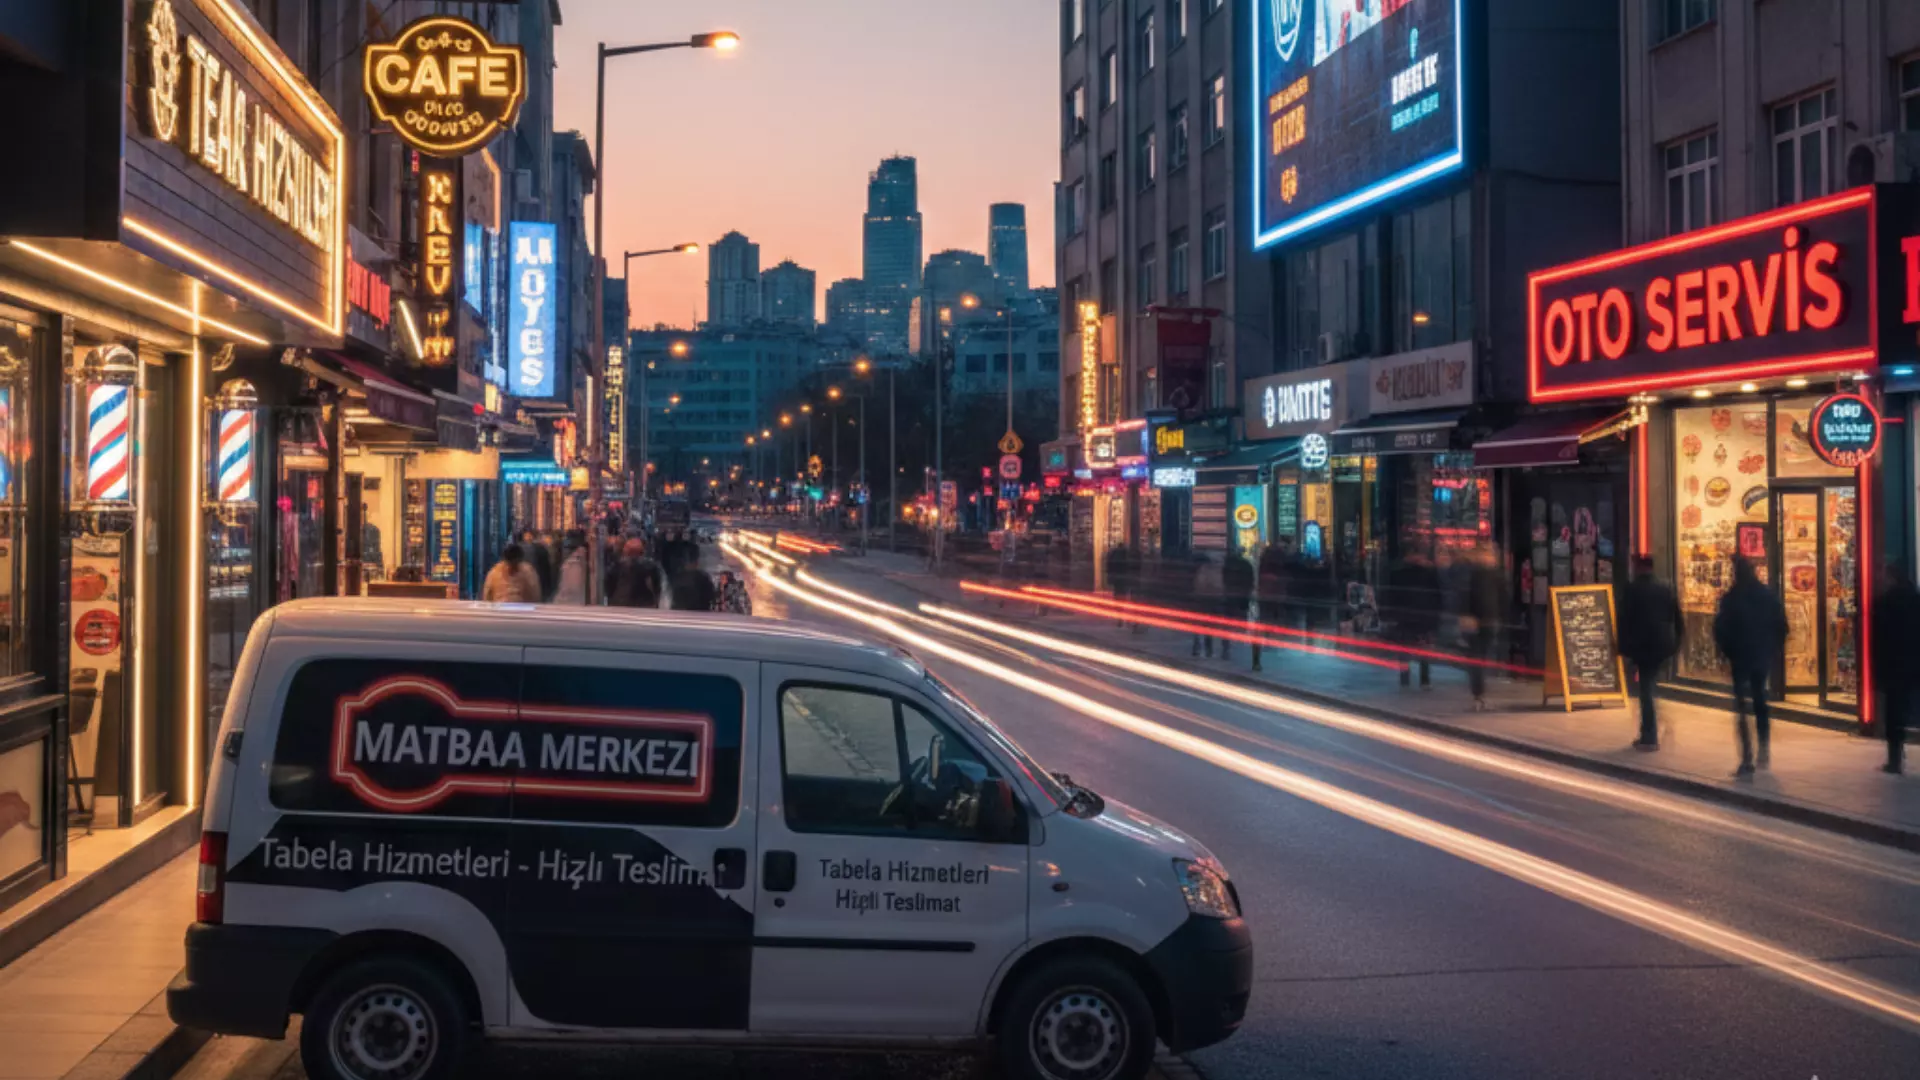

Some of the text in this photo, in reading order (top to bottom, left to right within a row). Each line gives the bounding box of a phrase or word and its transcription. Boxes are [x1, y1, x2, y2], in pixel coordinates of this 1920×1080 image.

[375, 54, 510, 97] CAFE
[1544, 287, 1632, 366] OTO
[353, 720, 699, 778] MATBAA MERKEZI
[259, 837, 354, 872] Tabela
[362, 842, 510, 879] Hizmetleri
[819, 858, 989, 885] Tabela Hizmetleri
[883, 892, 961, 913] Teslimat
